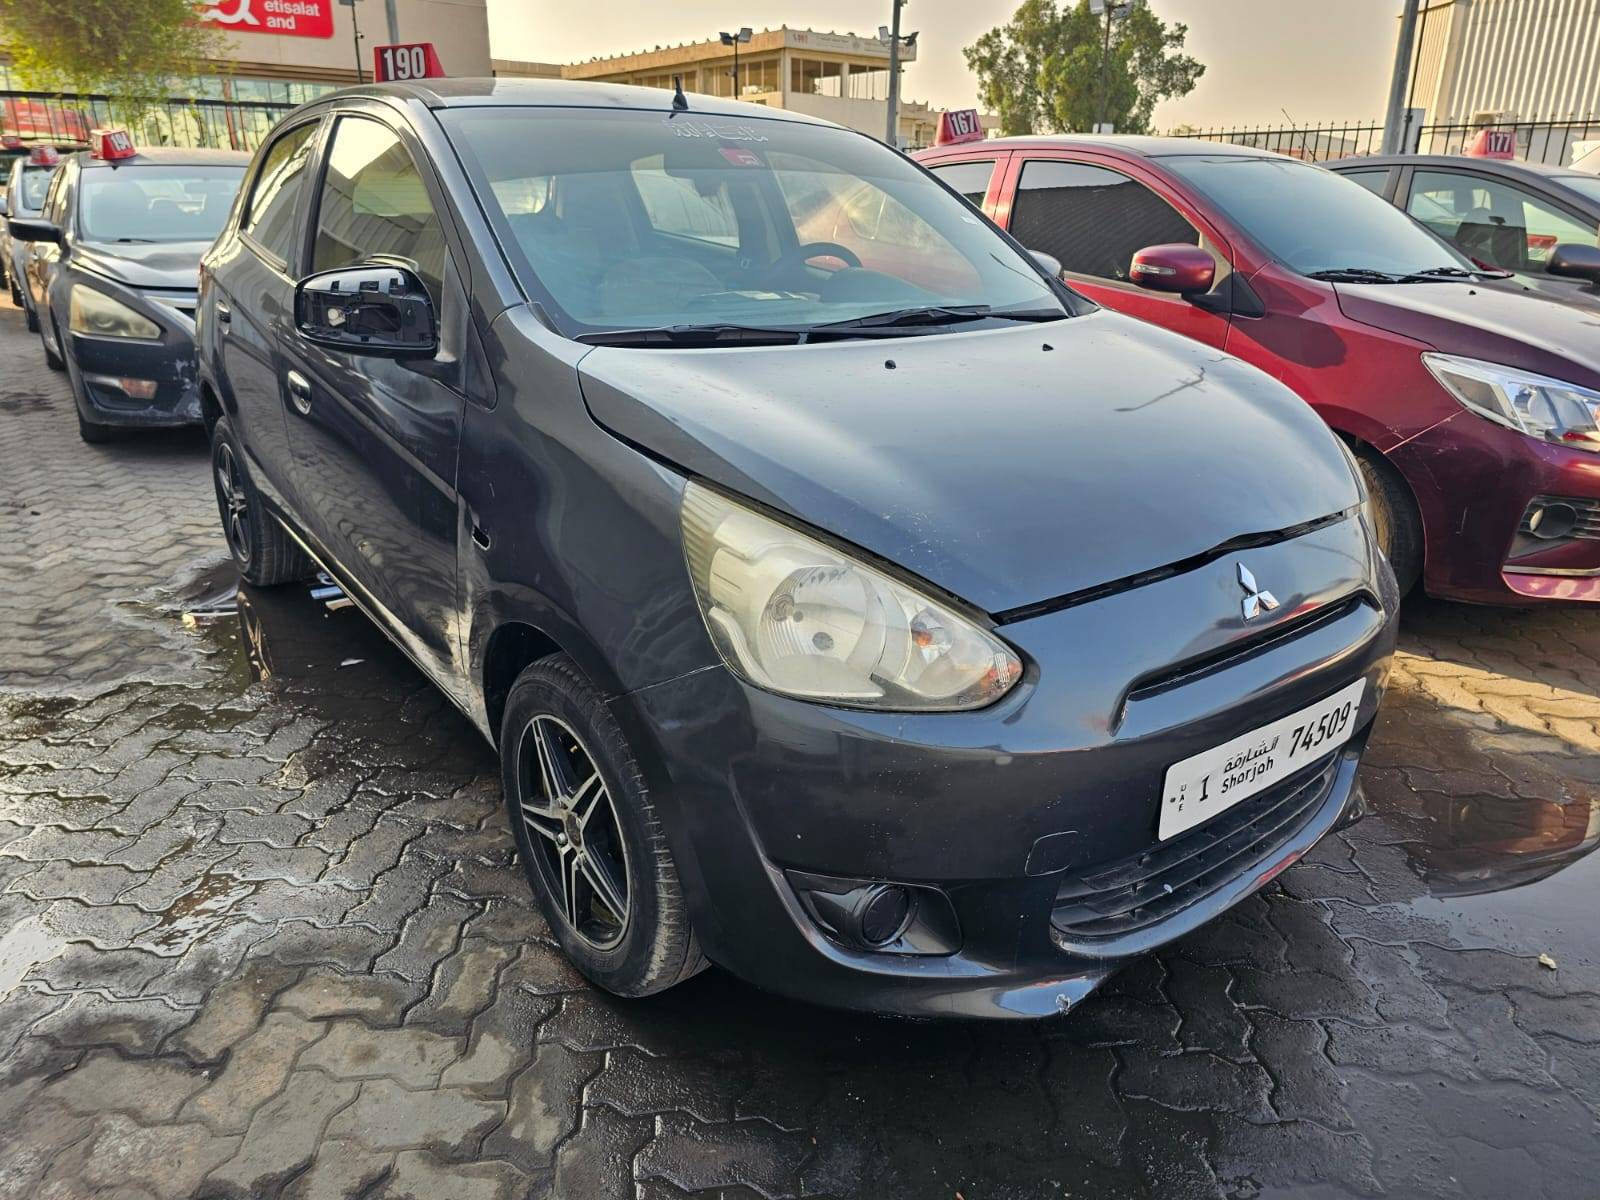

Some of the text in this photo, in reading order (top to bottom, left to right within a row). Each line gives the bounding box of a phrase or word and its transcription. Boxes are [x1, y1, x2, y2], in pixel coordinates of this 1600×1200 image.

[264, 0, 320, 16] etisalat
[266, 16, 296, 29] and
[383, 47, 426, 80] 190
[951, 111, 975, 135] 167
[1490, 132, 1511, 152] 177
[1289, 701, 1351, 758] 74509
[1223, 735, 1280, 774] الشارقة
[1220, 756, 1274, 794] Sharjah
